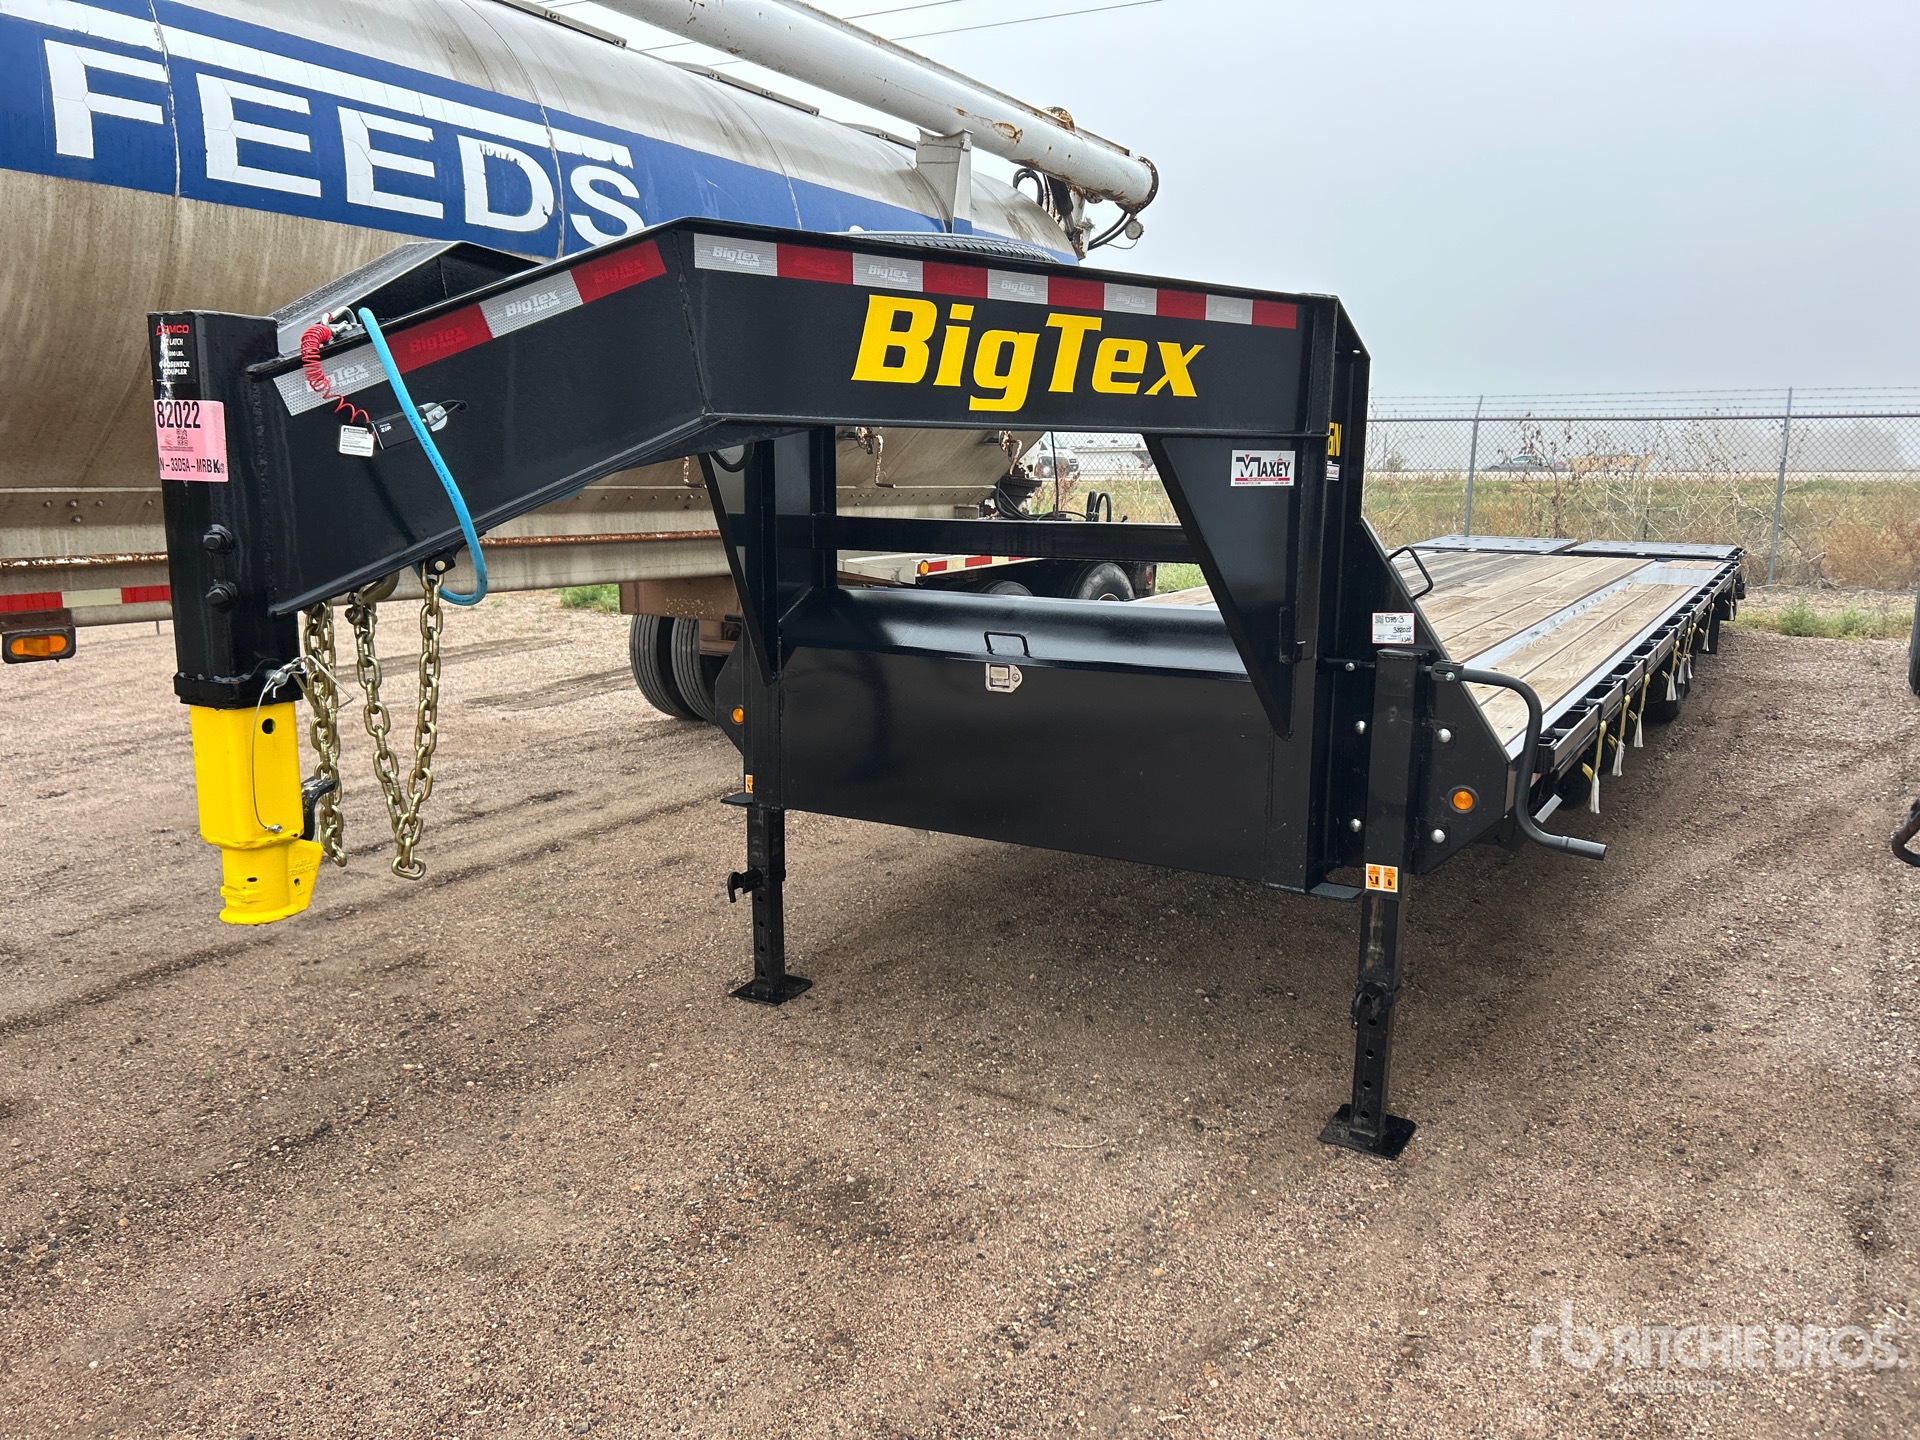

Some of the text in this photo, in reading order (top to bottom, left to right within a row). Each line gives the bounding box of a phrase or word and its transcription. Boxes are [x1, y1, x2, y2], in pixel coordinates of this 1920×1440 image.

[43, 38, 646, 247] FEEDS
[713, 246, 760, 262] BigTex
[868, 264, 909, 279] BigTex
[504, 289, 559, 318] BigTex
[852, 294, 1207, 413] BigTex
[156, 400, 201, 429] 82022
[1235, 455, 1292, 478] MAXEY
